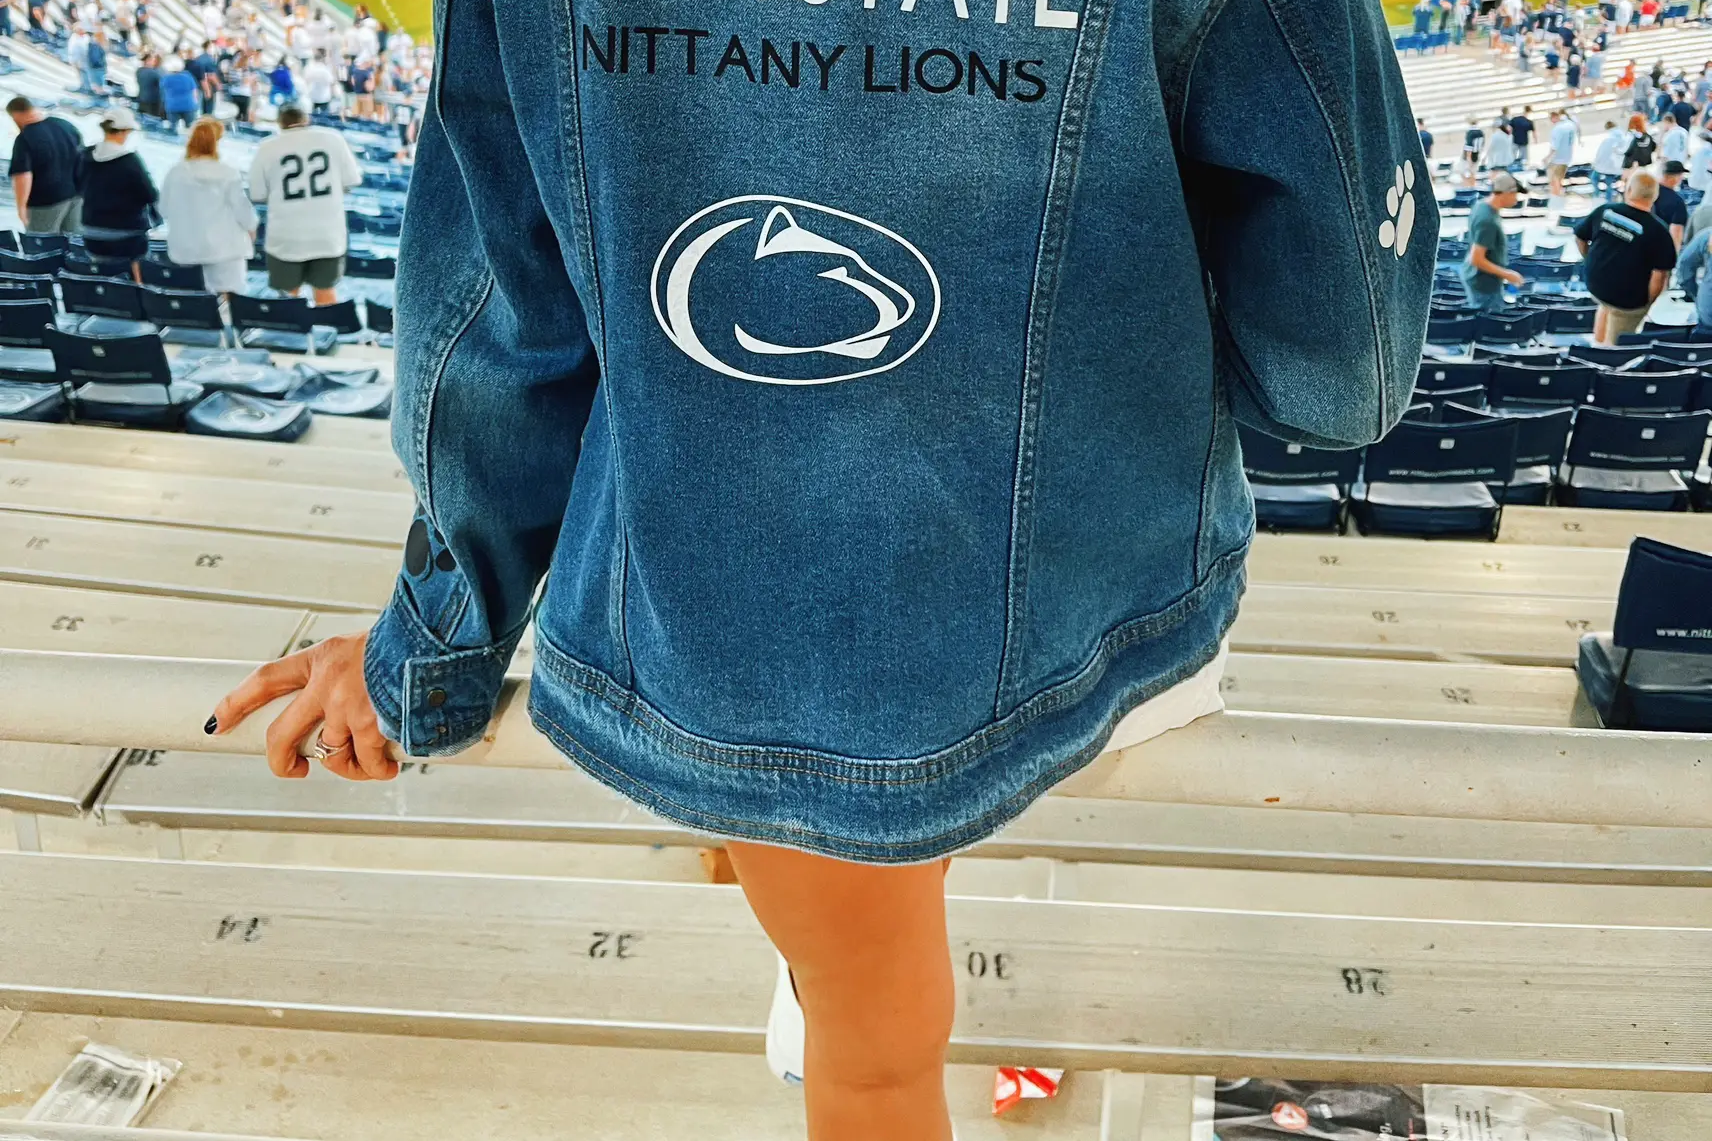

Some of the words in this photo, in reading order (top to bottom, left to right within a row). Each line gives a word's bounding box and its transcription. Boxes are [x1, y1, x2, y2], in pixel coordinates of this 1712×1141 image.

[581, 24, 846, 91] NITTANY
[864, 44, 1047, 102] LIONS
[280, 151, 332, 200] 22
[589, 932, 634, 960] 32
[968, 951, 1013, 980] 30
